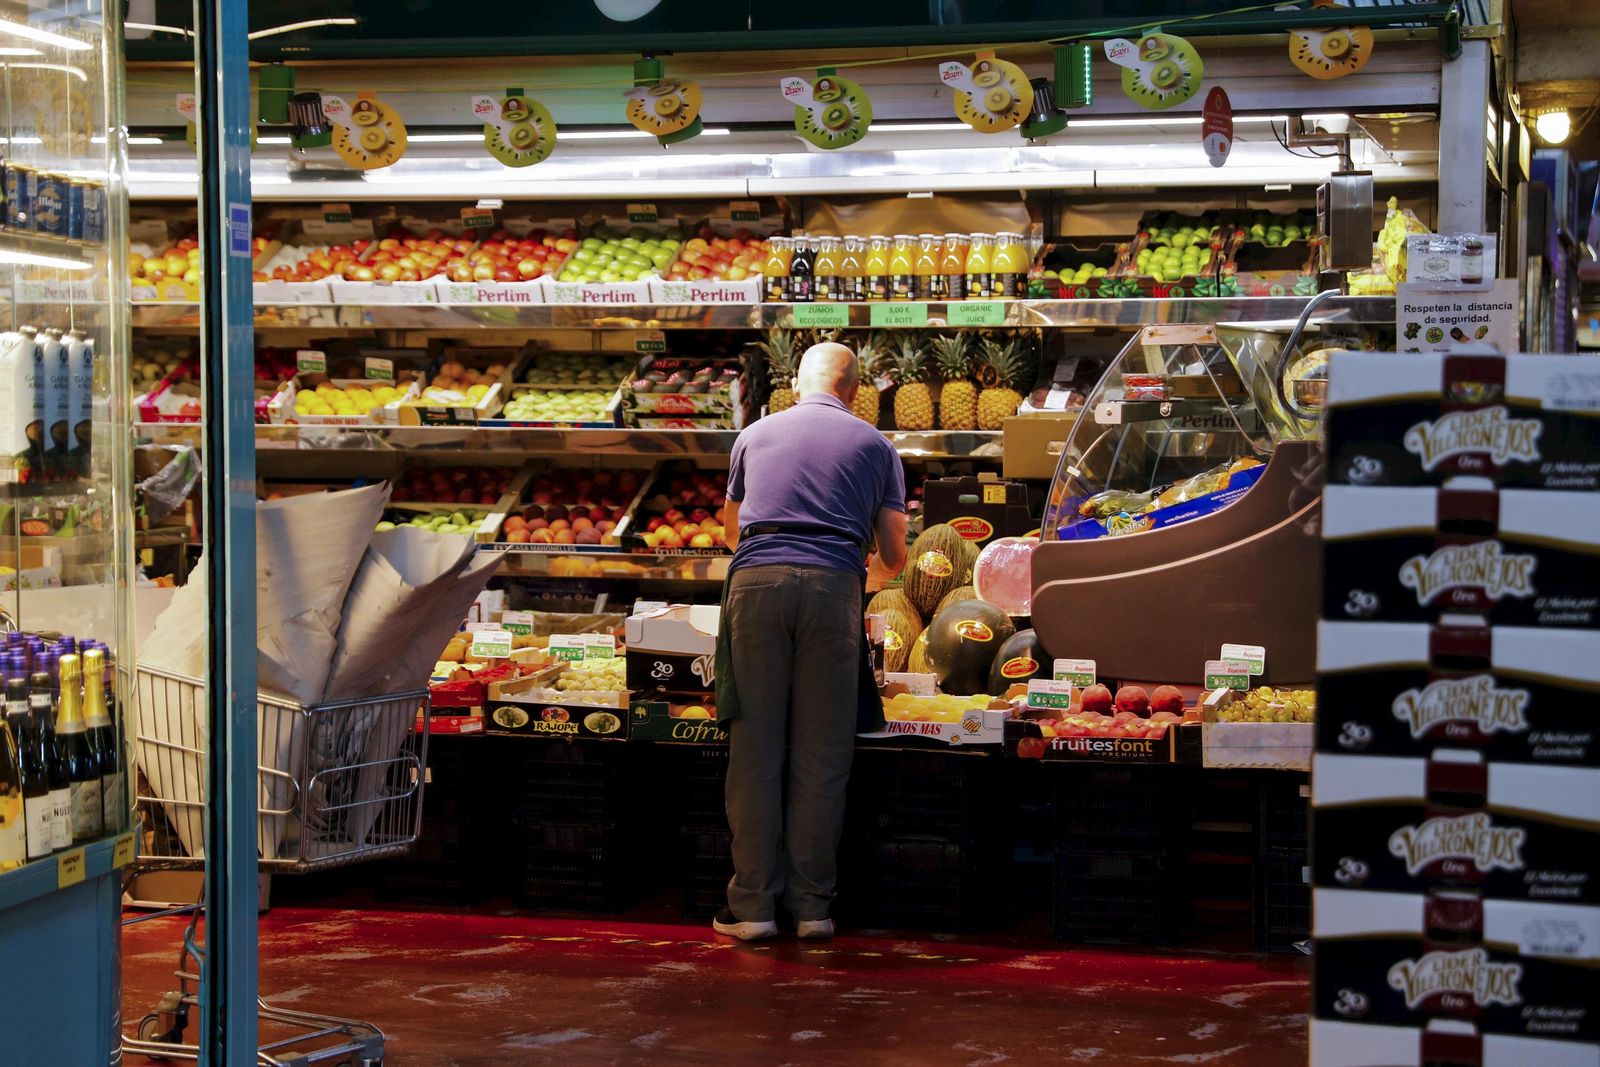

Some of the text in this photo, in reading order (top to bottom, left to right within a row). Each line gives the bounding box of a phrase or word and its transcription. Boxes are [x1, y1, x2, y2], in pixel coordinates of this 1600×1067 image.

[1109, 47, 1129, 58] Zespri
[943, 70, 963, 79] Zespri
[785, 86, 804, 95] Zespri
[324, 104, 344, 113] Zespri
[474, 103, 493, 112] Zespri
[478, 289, 531, 302] Perlim
[582, 289, 636, 302] Perlim
[691, 288, 746, 302] Perlim
[960, 305, 992, 313] ORGANIC
[1404, 302, 1513, 315] Respeten la distancia
[799, 316, 843, 324] ECOLOGICOS
[895, 316, 912, 324] BOTE
[966, 315, 985, 323] JUICE
[1424, 314, 1492, 325] de seguridad.
[1182, 413, 1241, 428] Perlim
[1451, 408, 1505, 431] LIDER
[1405, 420, 1541, 469] VILLACONEJOS
[1348, 456, 1382, 479] 30
[1444, 543, 1499, 565] LIDER
[1402, 556, 1535, 605] VILLACONEJOS
[1345, 590, 1378, 614] 30
[651, 661, 674, 678] 30
[1437, 678, 1490, 700] LIDER
[1394, 690, 1528, 738] VILLACONEJOS
[536, 721, 577, 732] RAJOPE
[888, 721, 942, 735] HNOS MAS
[1339, 722, 1372, 746] 30
[1051, 737, 1152, 752] fruitesfont
[1434, 816, 1486, 837] LIDER
[1390, 828, 1524, 875] VILLACONEJOS
[1335, 858, 1368, 881] 30
[1433, 952, 1482, 971] LIDER
[1388, 961, 1523, 1007] VILLACONEJOS
[1334, 989, 1367, 1013] 30
